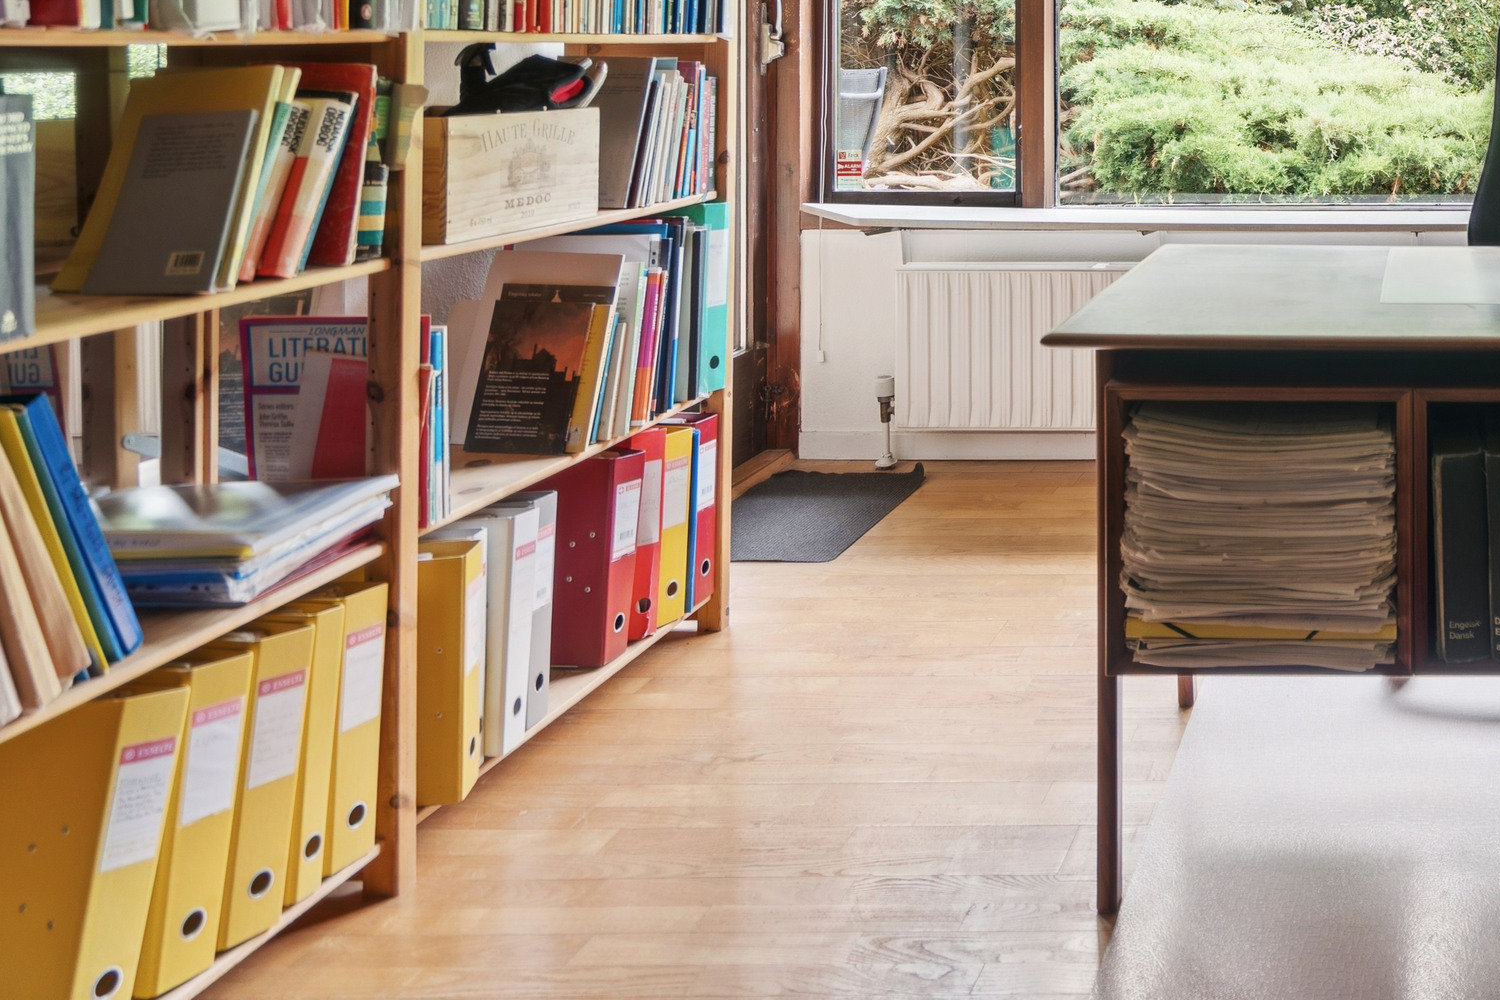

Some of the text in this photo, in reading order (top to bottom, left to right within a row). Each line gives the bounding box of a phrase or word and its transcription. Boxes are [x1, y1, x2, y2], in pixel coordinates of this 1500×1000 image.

[481, 118, 577, 153] HAUTE GRILLE
[307, 326, 367, 337] LONGMAN
[1448, 631, 1475, 640] Dansk
